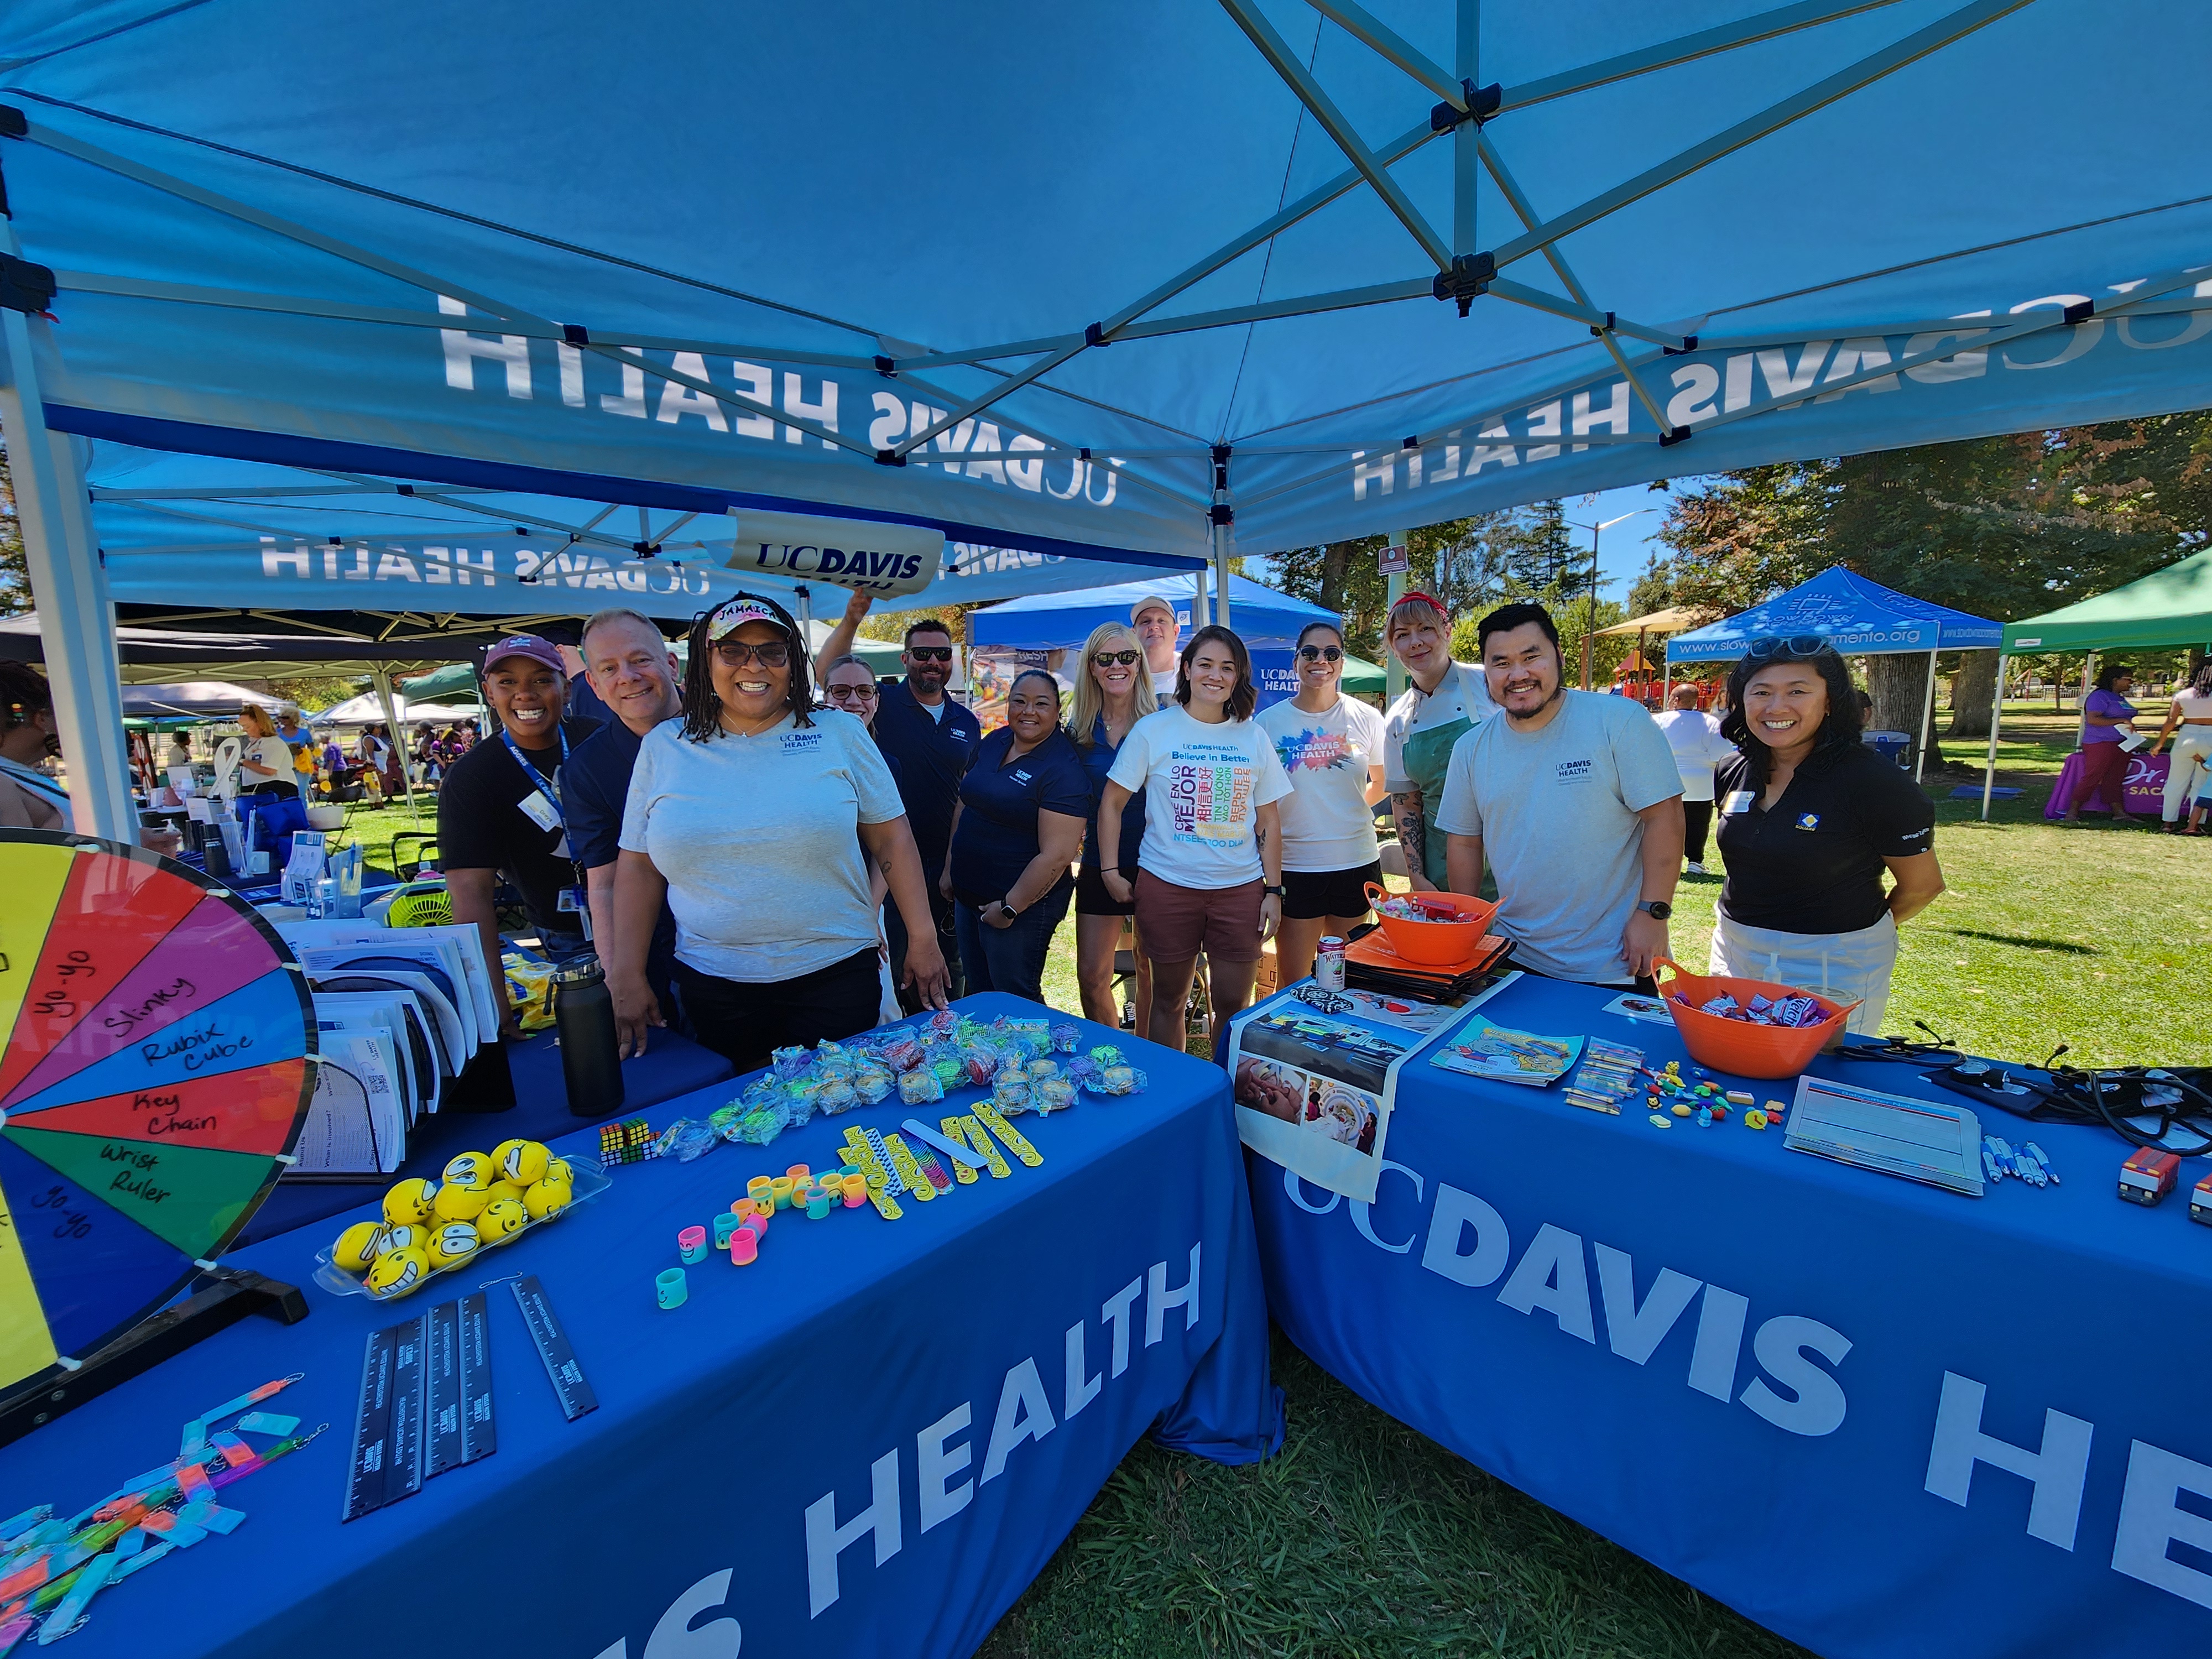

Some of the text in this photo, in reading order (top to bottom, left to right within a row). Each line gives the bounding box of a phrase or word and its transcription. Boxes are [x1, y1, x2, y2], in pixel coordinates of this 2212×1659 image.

[758, 543, 923, 579] UCDAVIS
[719, 604, 776, 620] JAMAICA
[1260, 669, 1300, 680] UCDA
[1265, 681, 1300, 691] HEALT
[780, 733, 822, 742] UCDAVIS
[784, 739, 817, 748] HEALTH
[1287, 741, 1339, 753] UCDAVIS
[1291, 750, 1335, 759] HEALTH
[510, 746, 528, 766] AGGIES
[1172, 751, 1206, 760] Believe
[1171, 765, 1181, 780] LO
[1556, 759, 1591, 771] UCDAVIS
[1559, 768, 1588, 777] HEALTH
[1171, 784, 1180, 799] EN
[1197, 766, 1213, 822] 相信更好
[1229, 767, 1243, 822] ВЕРЬТЕ В
[2130, 786, 2163, 795] SAC
[1180, 765, 1196, 832] MEJOR
[104, 978, 196, 1038] Slinky
[1784, 997, 1807, 1025] Welch
[1489, 1029, 1528, 1041] HEALTHY
[142, 1023, 224, 1067] Rubix
[133, 1094, 180, 1115] Key
[1892, 1101, 1923, 1112] Notes
[100, 1144, 159, 1171] Wrist
[109, 1170, 171, 1203] Ruler
[805, 1241, 1201, 1620] HEALTH
